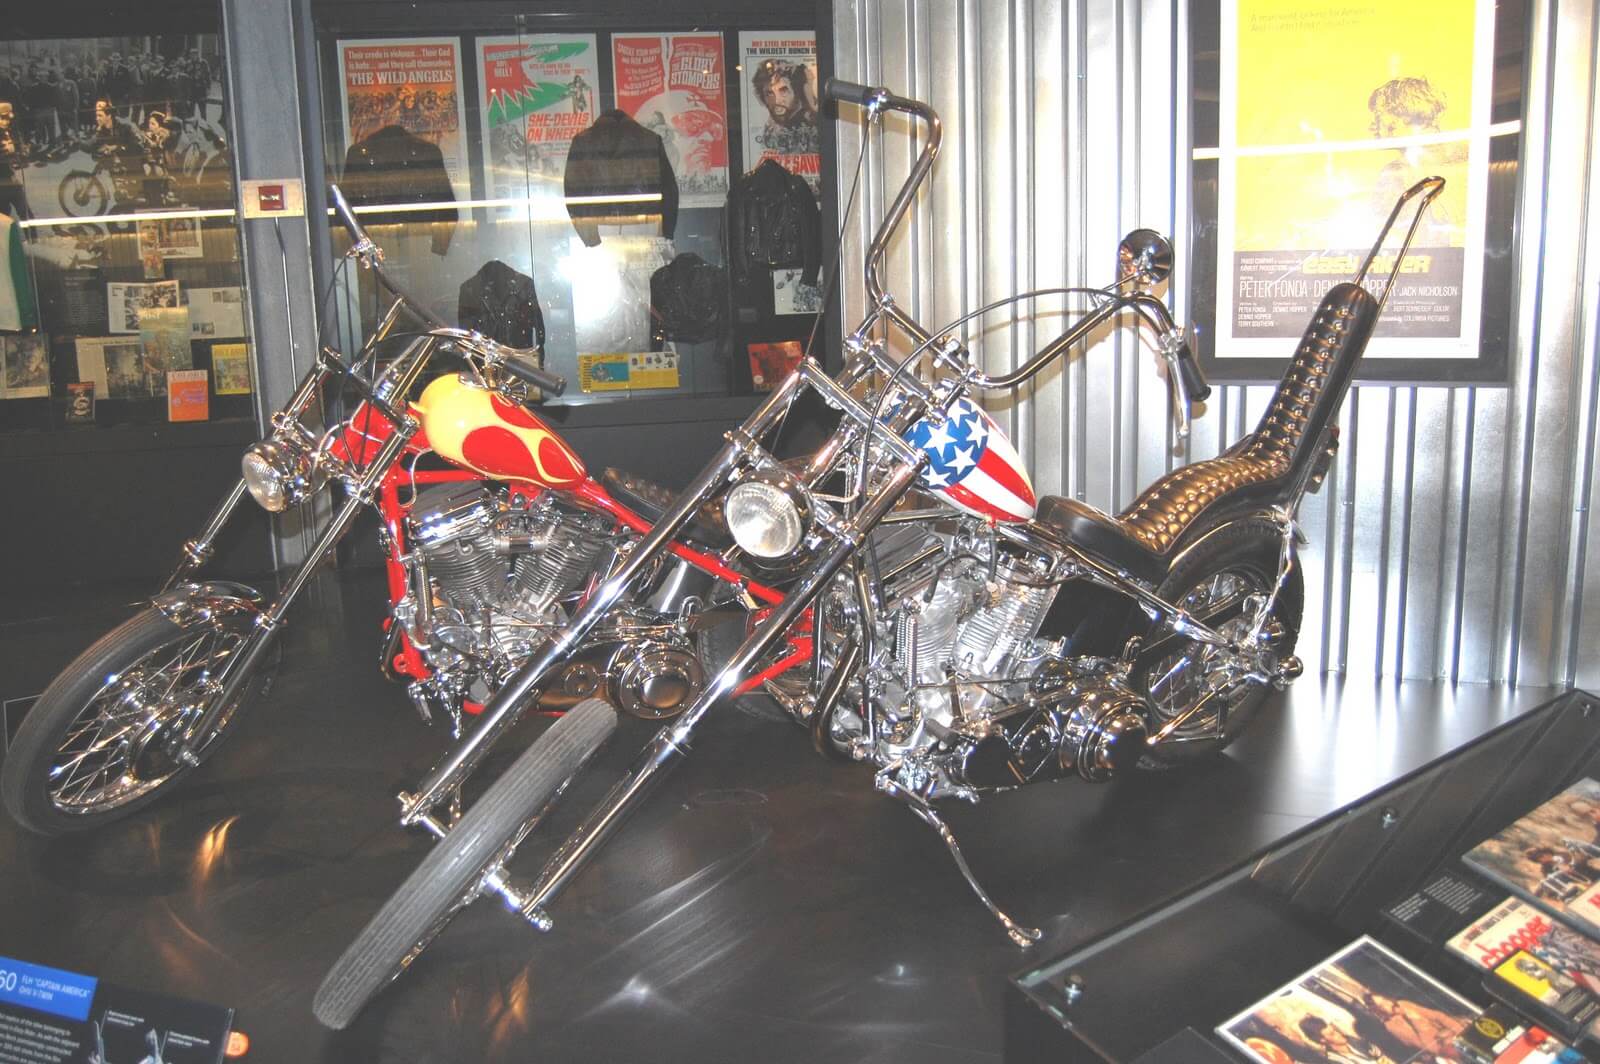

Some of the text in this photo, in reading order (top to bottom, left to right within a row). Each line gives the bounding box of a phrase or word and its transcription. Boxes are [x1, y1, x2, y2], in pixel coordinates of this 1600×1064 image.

[681, 56, 716, 73] GLORY
[377, 71, 406, 84] WILD
[407, 70, 453, 82] ANGELS
[671, 70, 720, 89] STOMPERS
[528, 112, 589, 126] SHE-DEVILS
[527, 128, 543, 143] ON
[1239, 280, 1272, 297] PETER
[1274, 280, 1307, 297] FONDA
[1400, 287, 1417, 296] JACK
[1418, 286, 1458, 296] NICHOLSON
